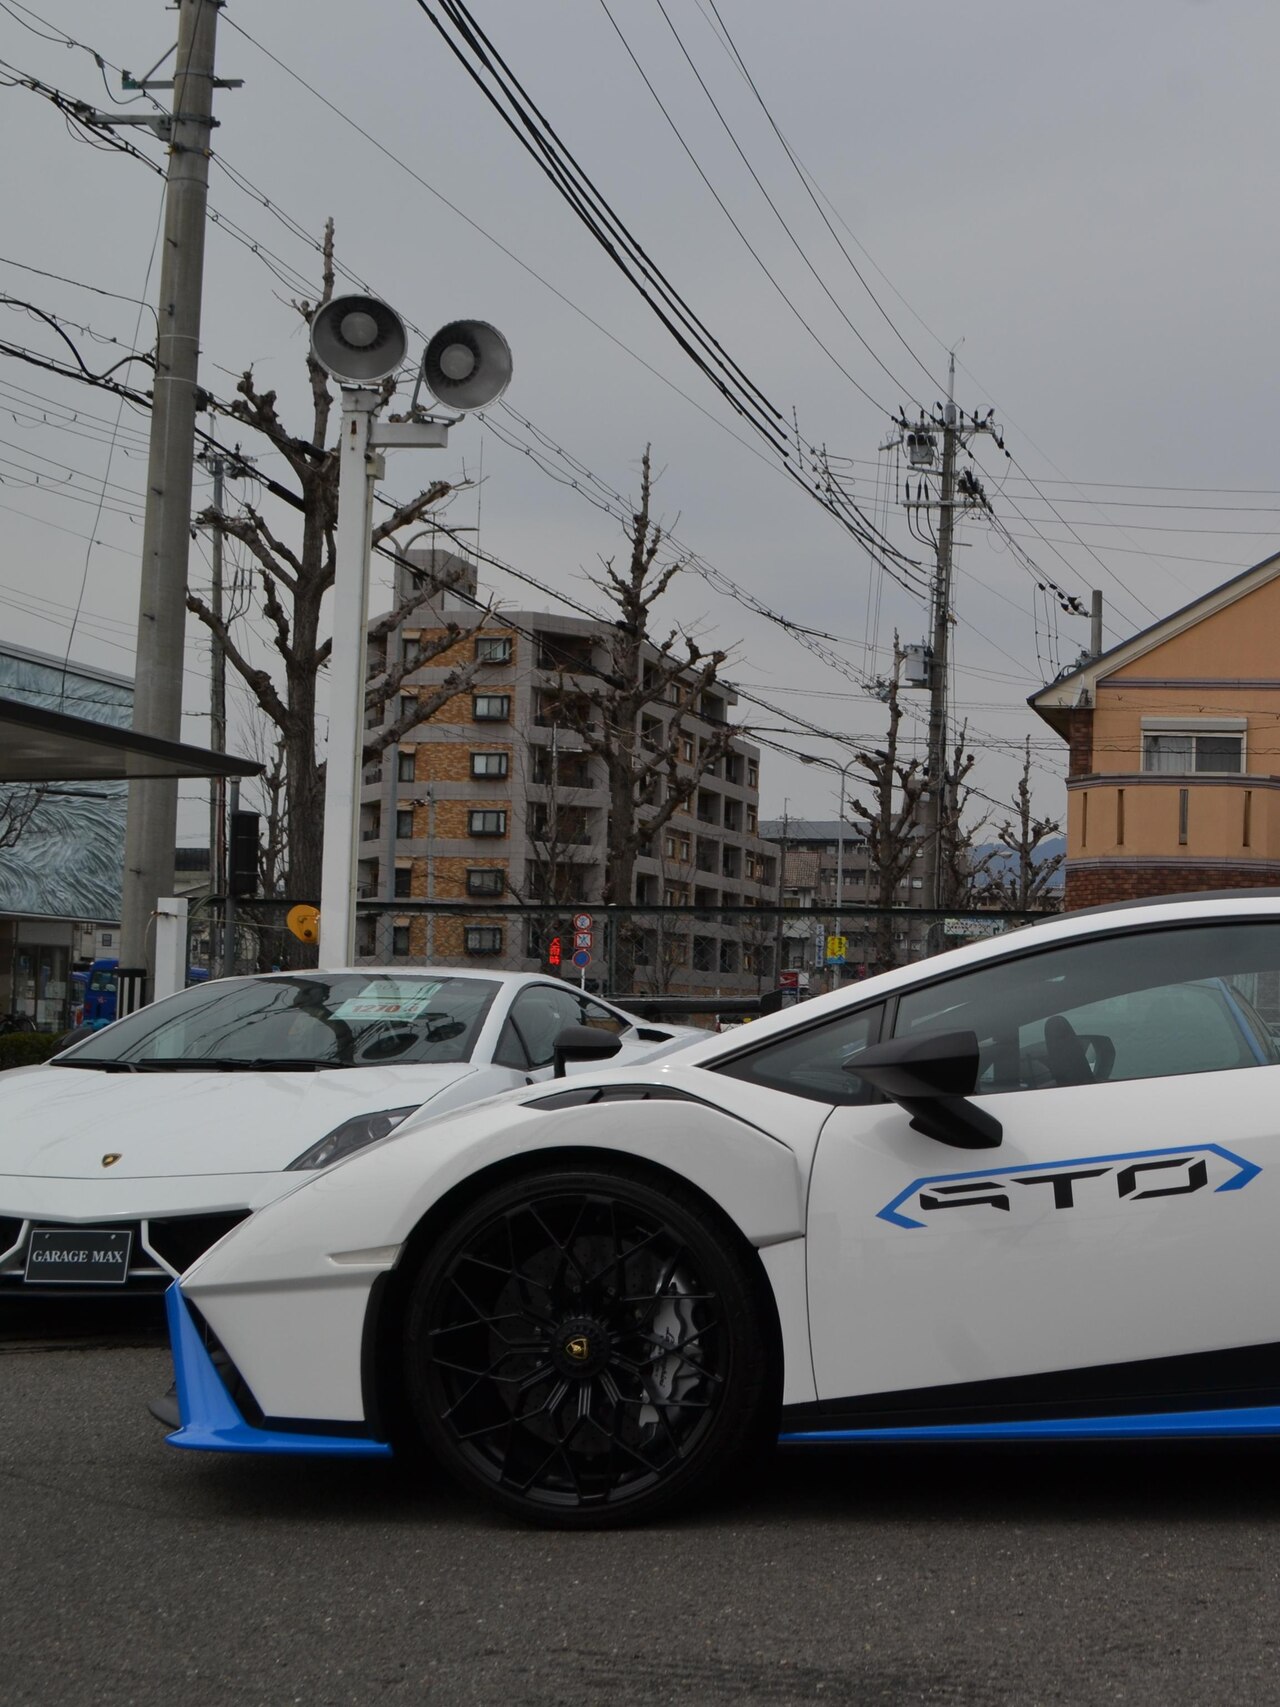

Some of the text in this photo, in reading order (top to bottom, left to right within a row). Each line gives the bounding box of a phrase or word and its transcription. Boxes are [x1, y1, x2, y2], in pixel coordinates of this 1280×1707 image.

[919, 1157, 1208, 1211] STO
[32, 1250, 123, 1263] GARAGE MAX
